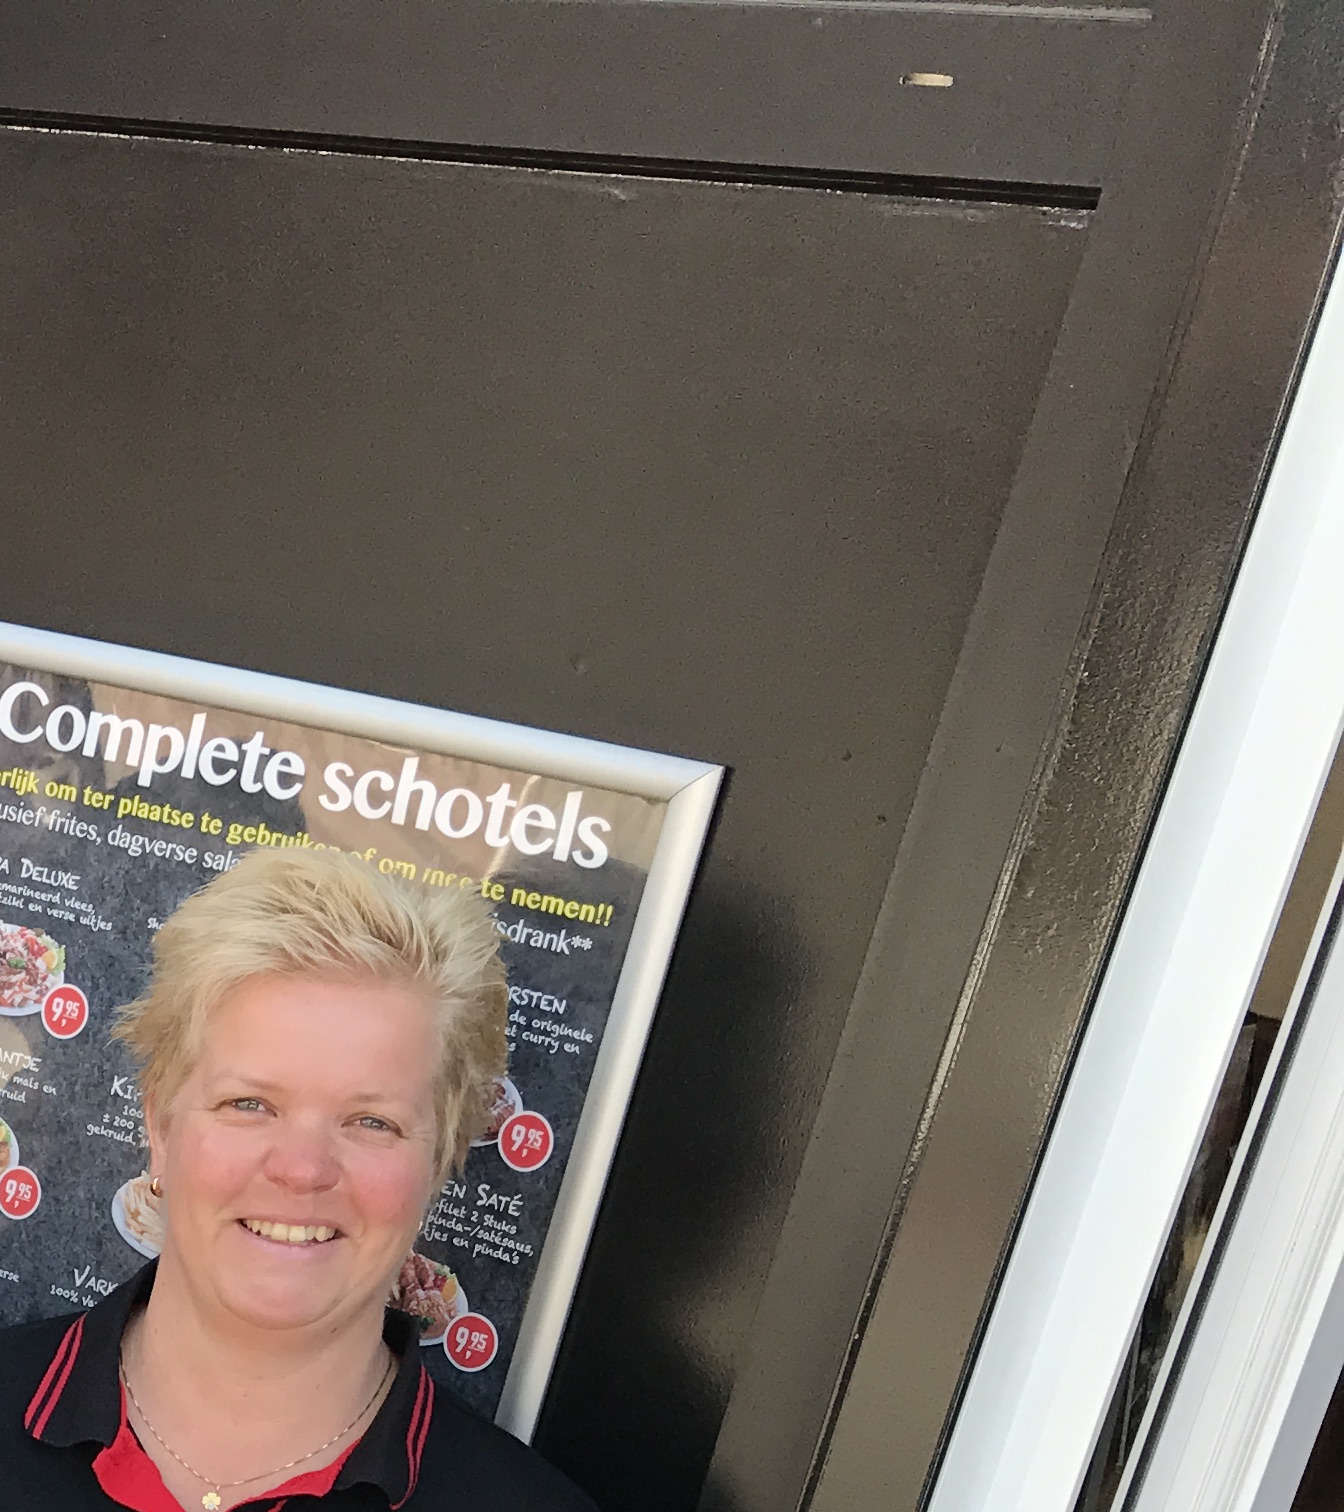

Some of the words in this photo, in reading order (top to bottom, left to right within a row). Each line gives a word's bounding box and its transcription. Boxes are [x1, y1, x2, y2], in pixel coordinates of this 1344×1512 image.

[317, 751, 615, 870] schotels
[48, 810, 103, 846] frites,
[107, 824, 199, 864] dagverse
[45, 781, 77, 803] om
[83, 786, 115, 810] ter
[117, 797, 194, 829] plaatse
[200, 811, 222, 836] te
[481, 877, 505, 902] te
[511, 887, 614, 928] nemen!!
[28, 902, 43, 913] en
[46, 906, 76, 923] verse
[80, 913, 113, 932] uitjes
[64, 896, 95, 915] vlees,
[13, 1075, 40, 1090] mals
[42, 1084, 58, 1096] en
[511, 1124, 545, 1158] 9,95
[4, 1179, 32, 1208] 9,95
[454, 1326, 489, 1360] 9,95
